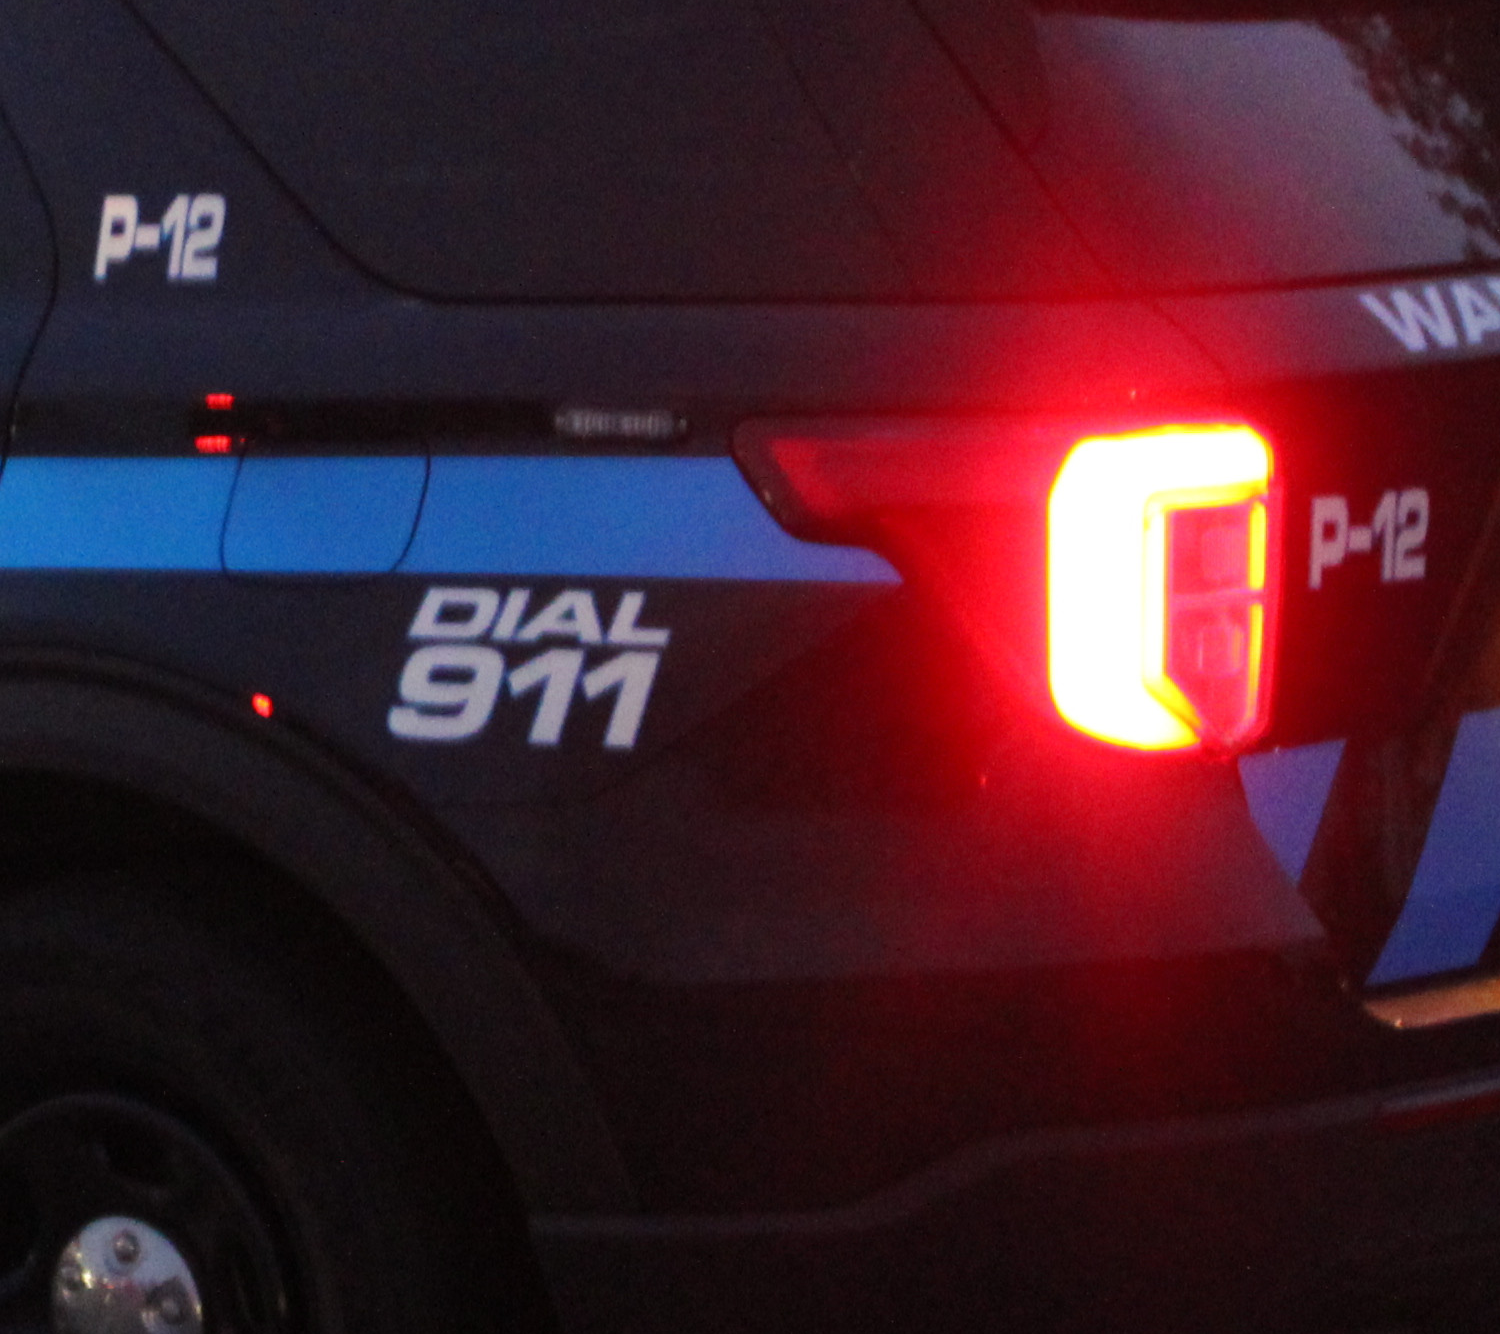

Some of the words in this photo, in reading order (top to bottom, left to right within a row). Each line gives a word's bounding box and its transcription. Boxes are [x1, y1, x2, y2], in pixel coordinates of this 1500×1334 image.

[94, 193, 226, 283] P-12
[1309, 487, 1431, 590] P-12
[407, 586, 671, 647] DIAL
[386, 644, 661, 750] 911
